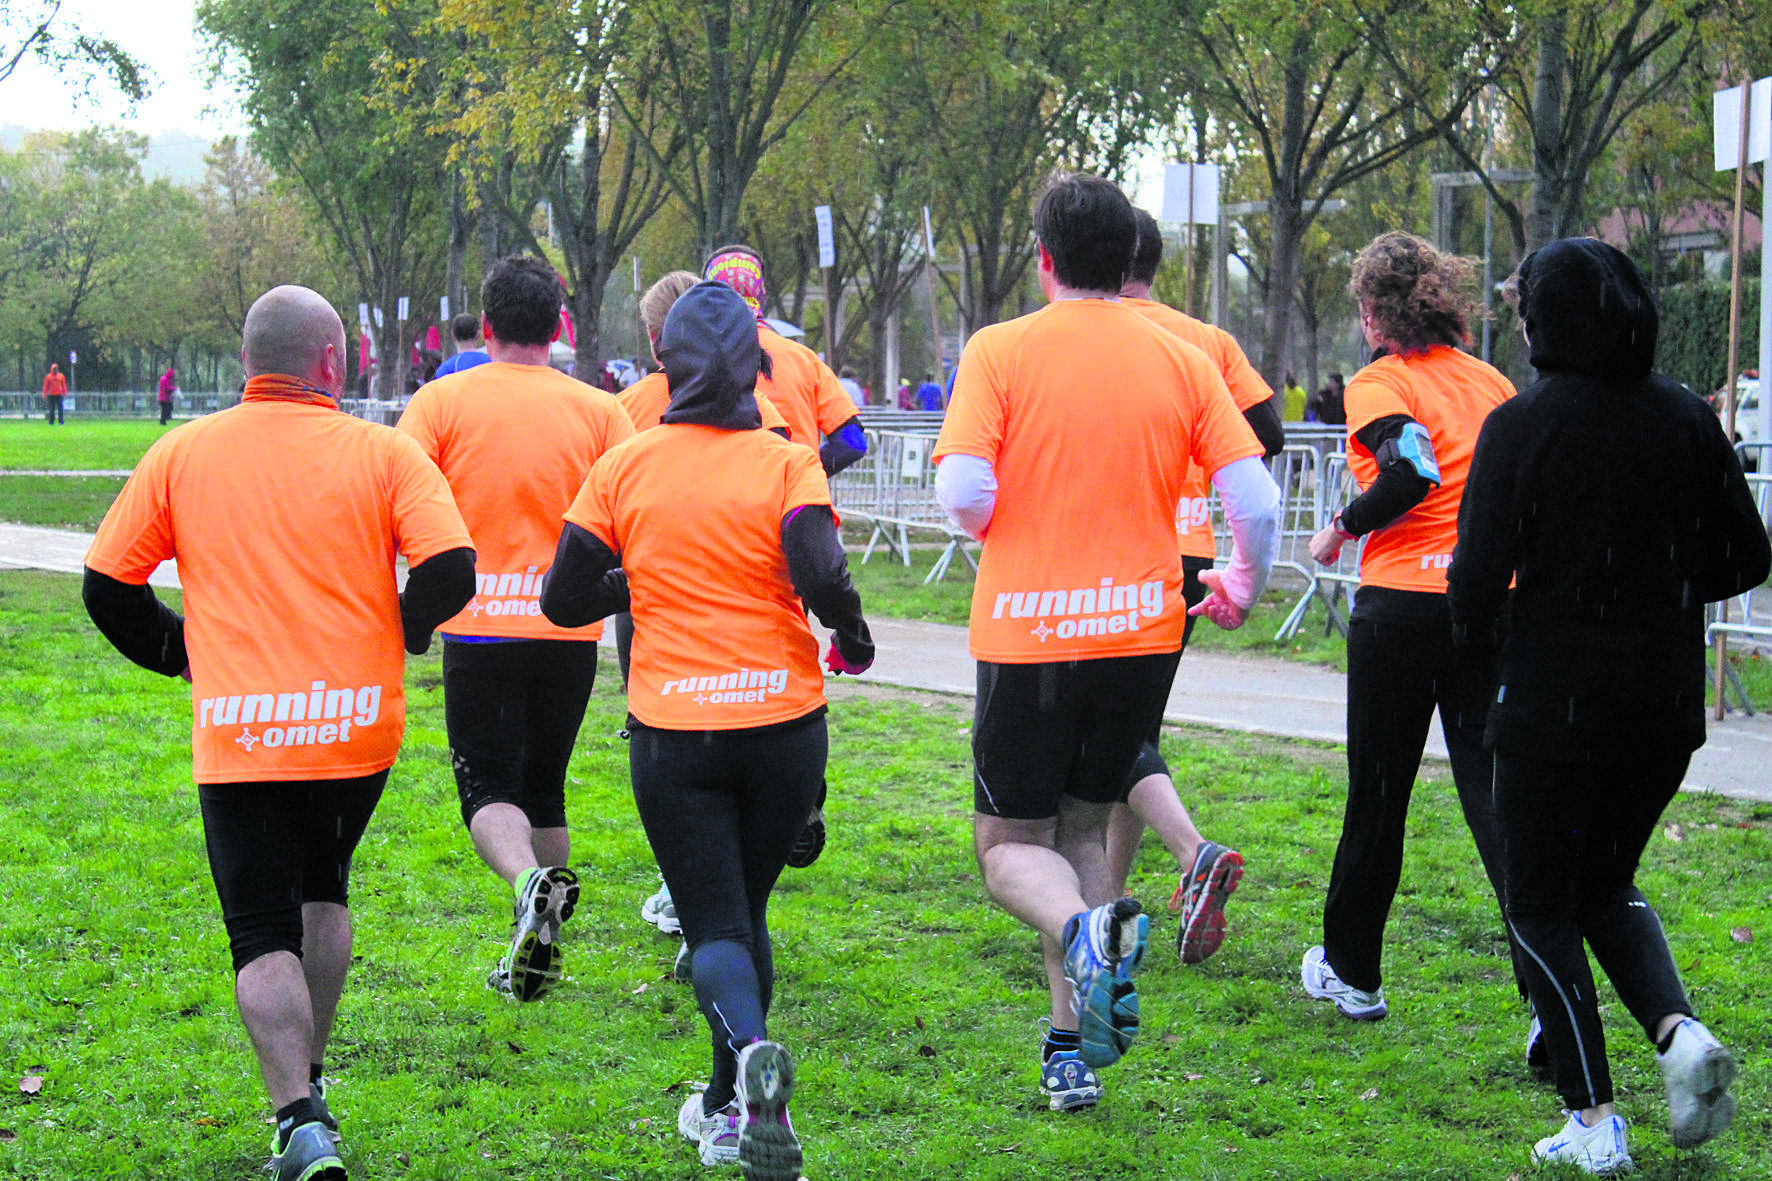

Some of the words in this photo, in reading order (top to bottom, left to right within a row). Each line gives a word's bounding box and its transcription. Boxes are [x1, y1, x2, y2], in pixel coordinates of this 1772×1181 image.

[485, 599, 543, 616] ome
[992, 577, 1164, 619] running
[1056, 610, 1140, 639] omet
[660, 667, 788, 696] running
[709, 687, 767, 704] omet
[200, 680, 382, 728] running
[262, 718, 352, 748] omet
